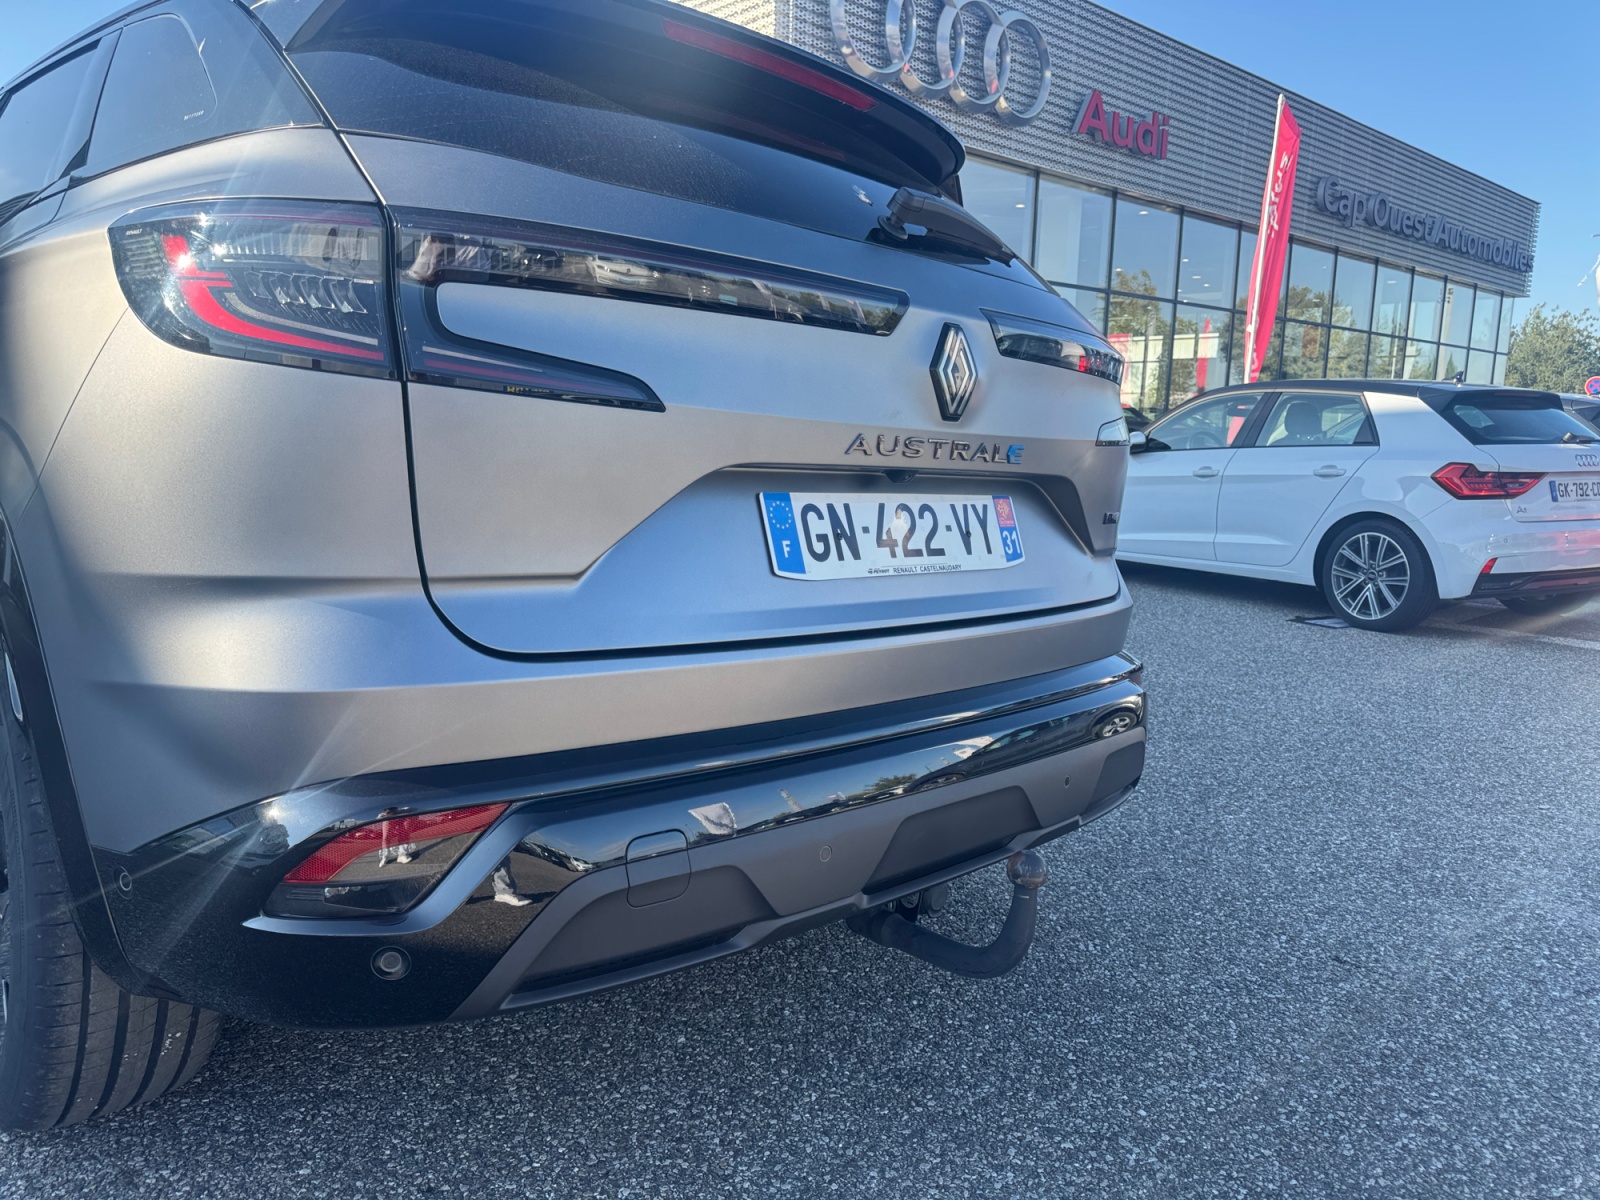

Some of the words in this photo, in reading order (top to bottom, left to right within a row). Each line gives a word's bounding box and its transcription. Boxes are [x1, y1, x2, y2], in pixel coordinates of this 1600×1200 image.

[1072, 88, 1170, 160] Audi
[1317, 175, 1367, 227] Cap
[1367, 192, 1438, 242] Ouest
[1432, 214, 1534, 273] Automobiles
[782, 540, 791, 558] F
[801, 502, 993, 563] GN-422-VY
[1002, 530, 1021, 554] 31
[893, 566, 918, 574] RENAULT
[919, 564, 962, 573] CASTELNAUDARY
